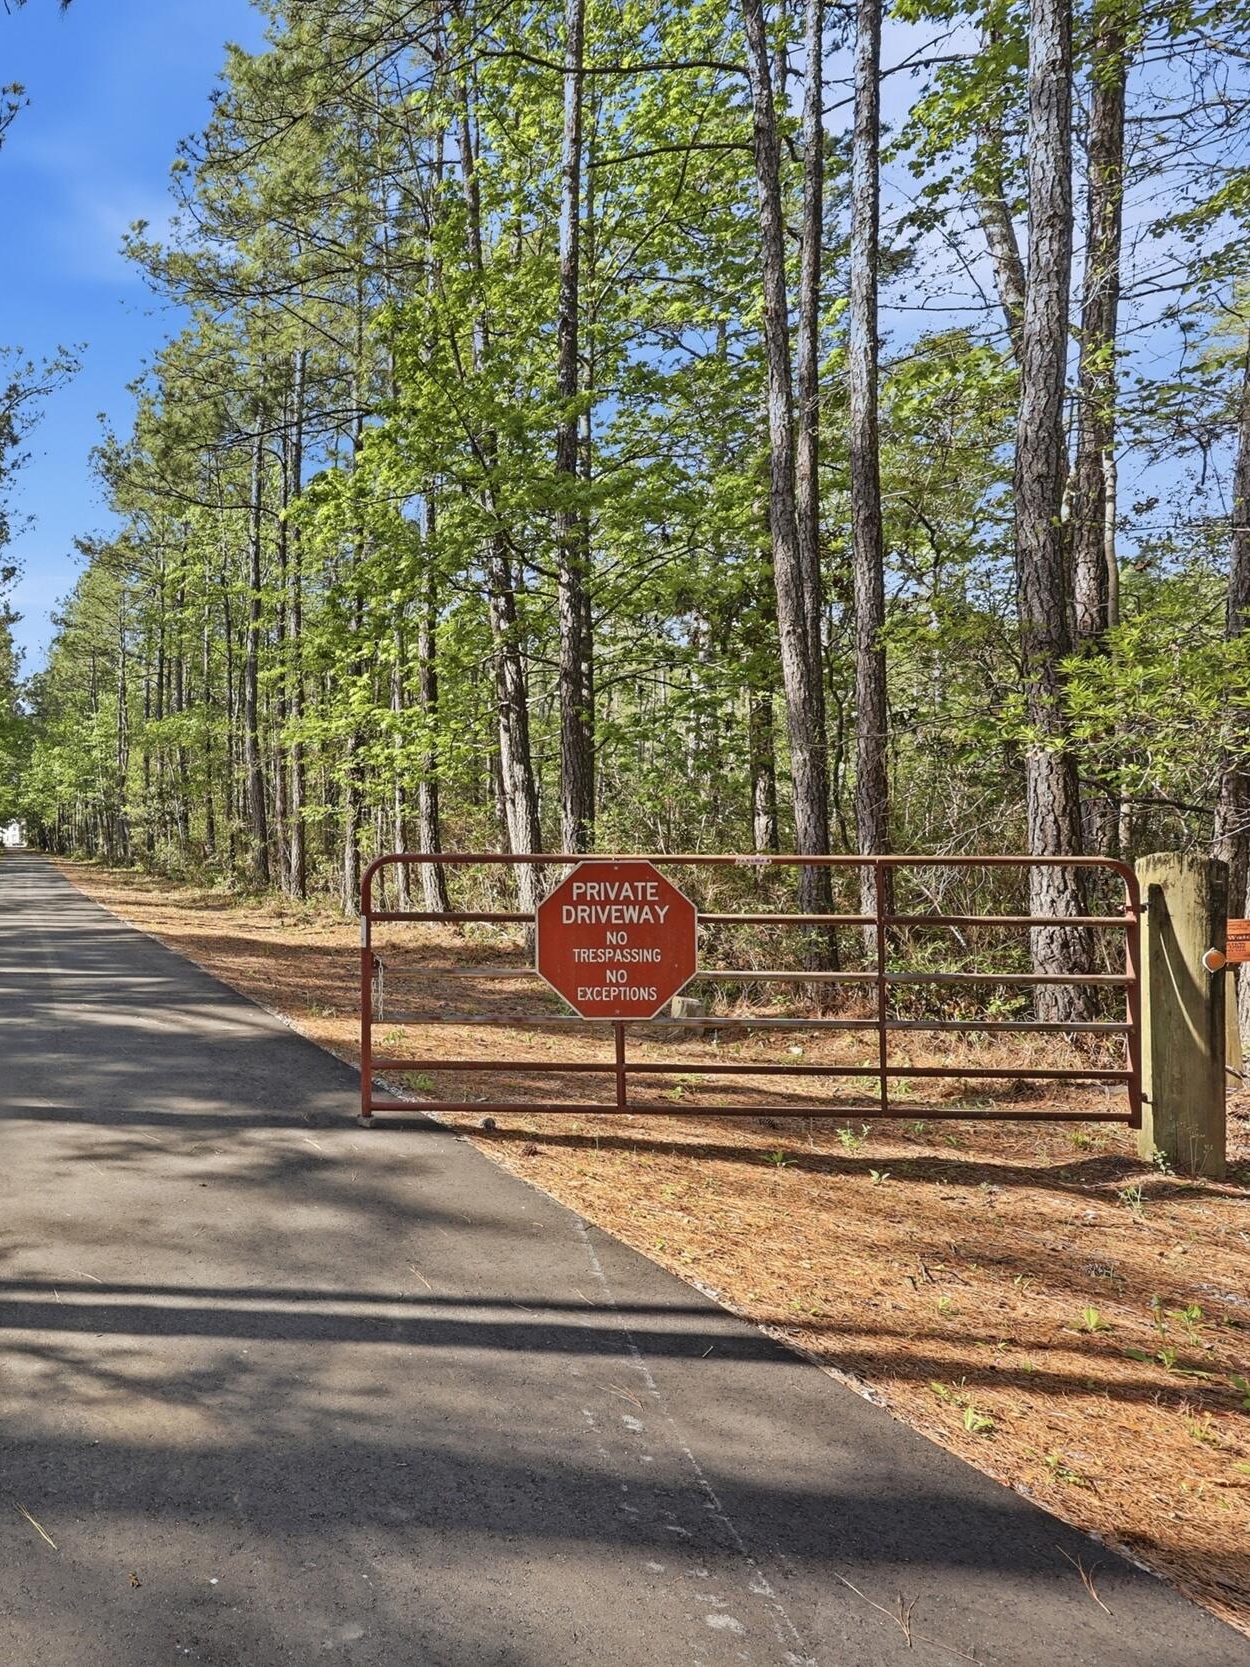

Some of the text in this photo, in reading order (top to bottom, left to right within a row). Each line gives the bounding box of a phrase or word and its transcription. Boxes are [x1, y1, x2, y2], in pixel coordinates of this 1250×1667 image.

[572, 882, 659, 901] PRIVATE
[562, 905, 670, 924] DRIVEWAY
[606, 931, 627, 945] NO
[573, 949, 661, 963] TRESPASSING
[606, 969, 627, 983] NO
[577, 987, 657, 1001] EXCEPTIONS
